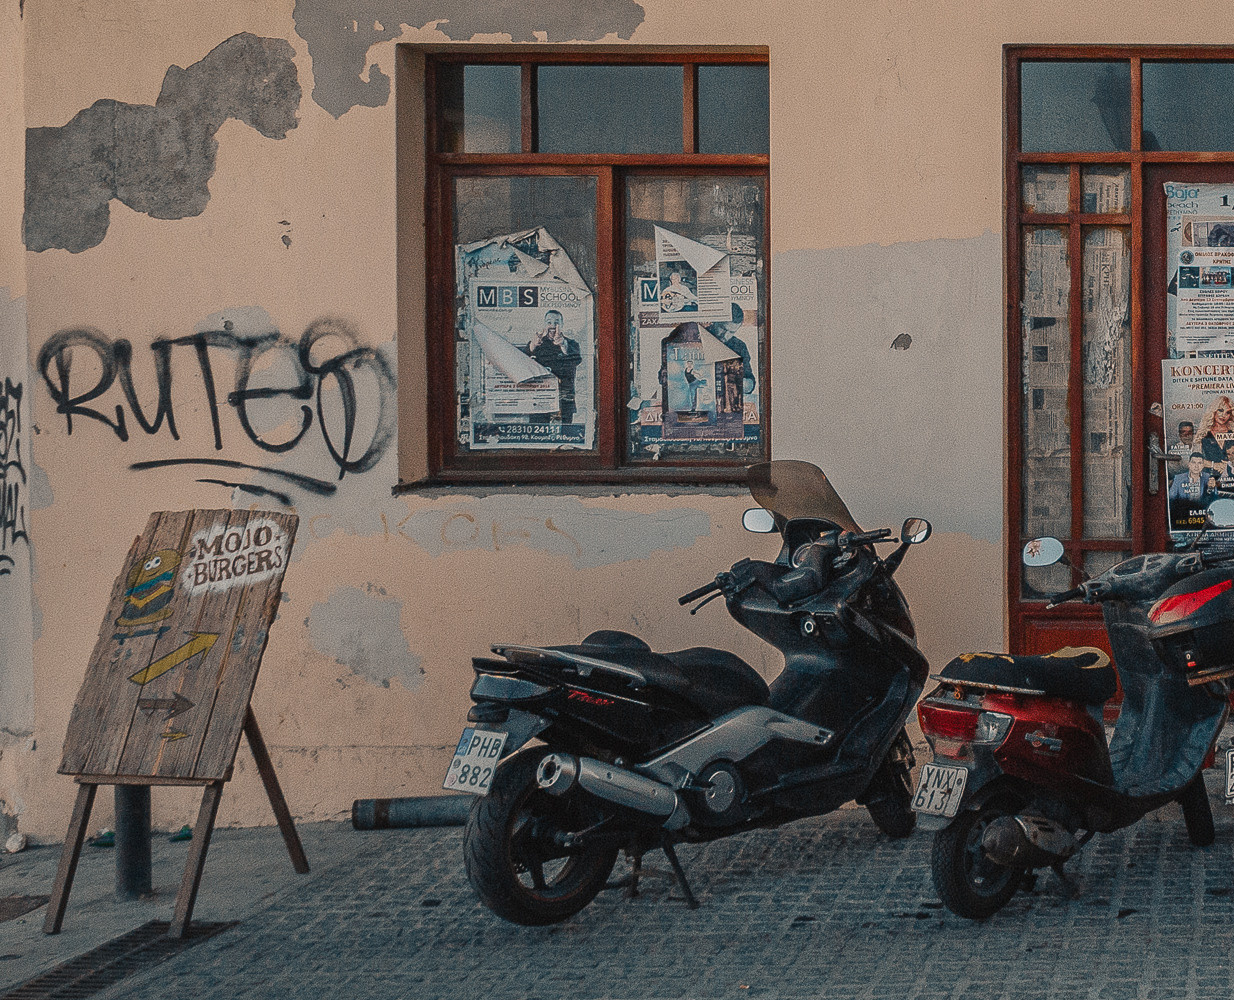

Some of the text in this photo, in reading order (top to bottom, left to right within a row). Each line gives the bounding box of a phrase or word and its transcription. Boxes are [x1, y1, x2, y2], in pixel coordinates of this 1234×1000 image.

[479, 288, 534, 305] MBS
[506, 425, 533, 434] 28310
[197, 525, 273, 560] MOJO
[193, 545, 283, 587] BURGERS
[467, 735, 501, 759] PHB
[458, 764, 492, 788] 882
[926, 767, 955, 790] YNX
[915, 789, 947, 811] 613
